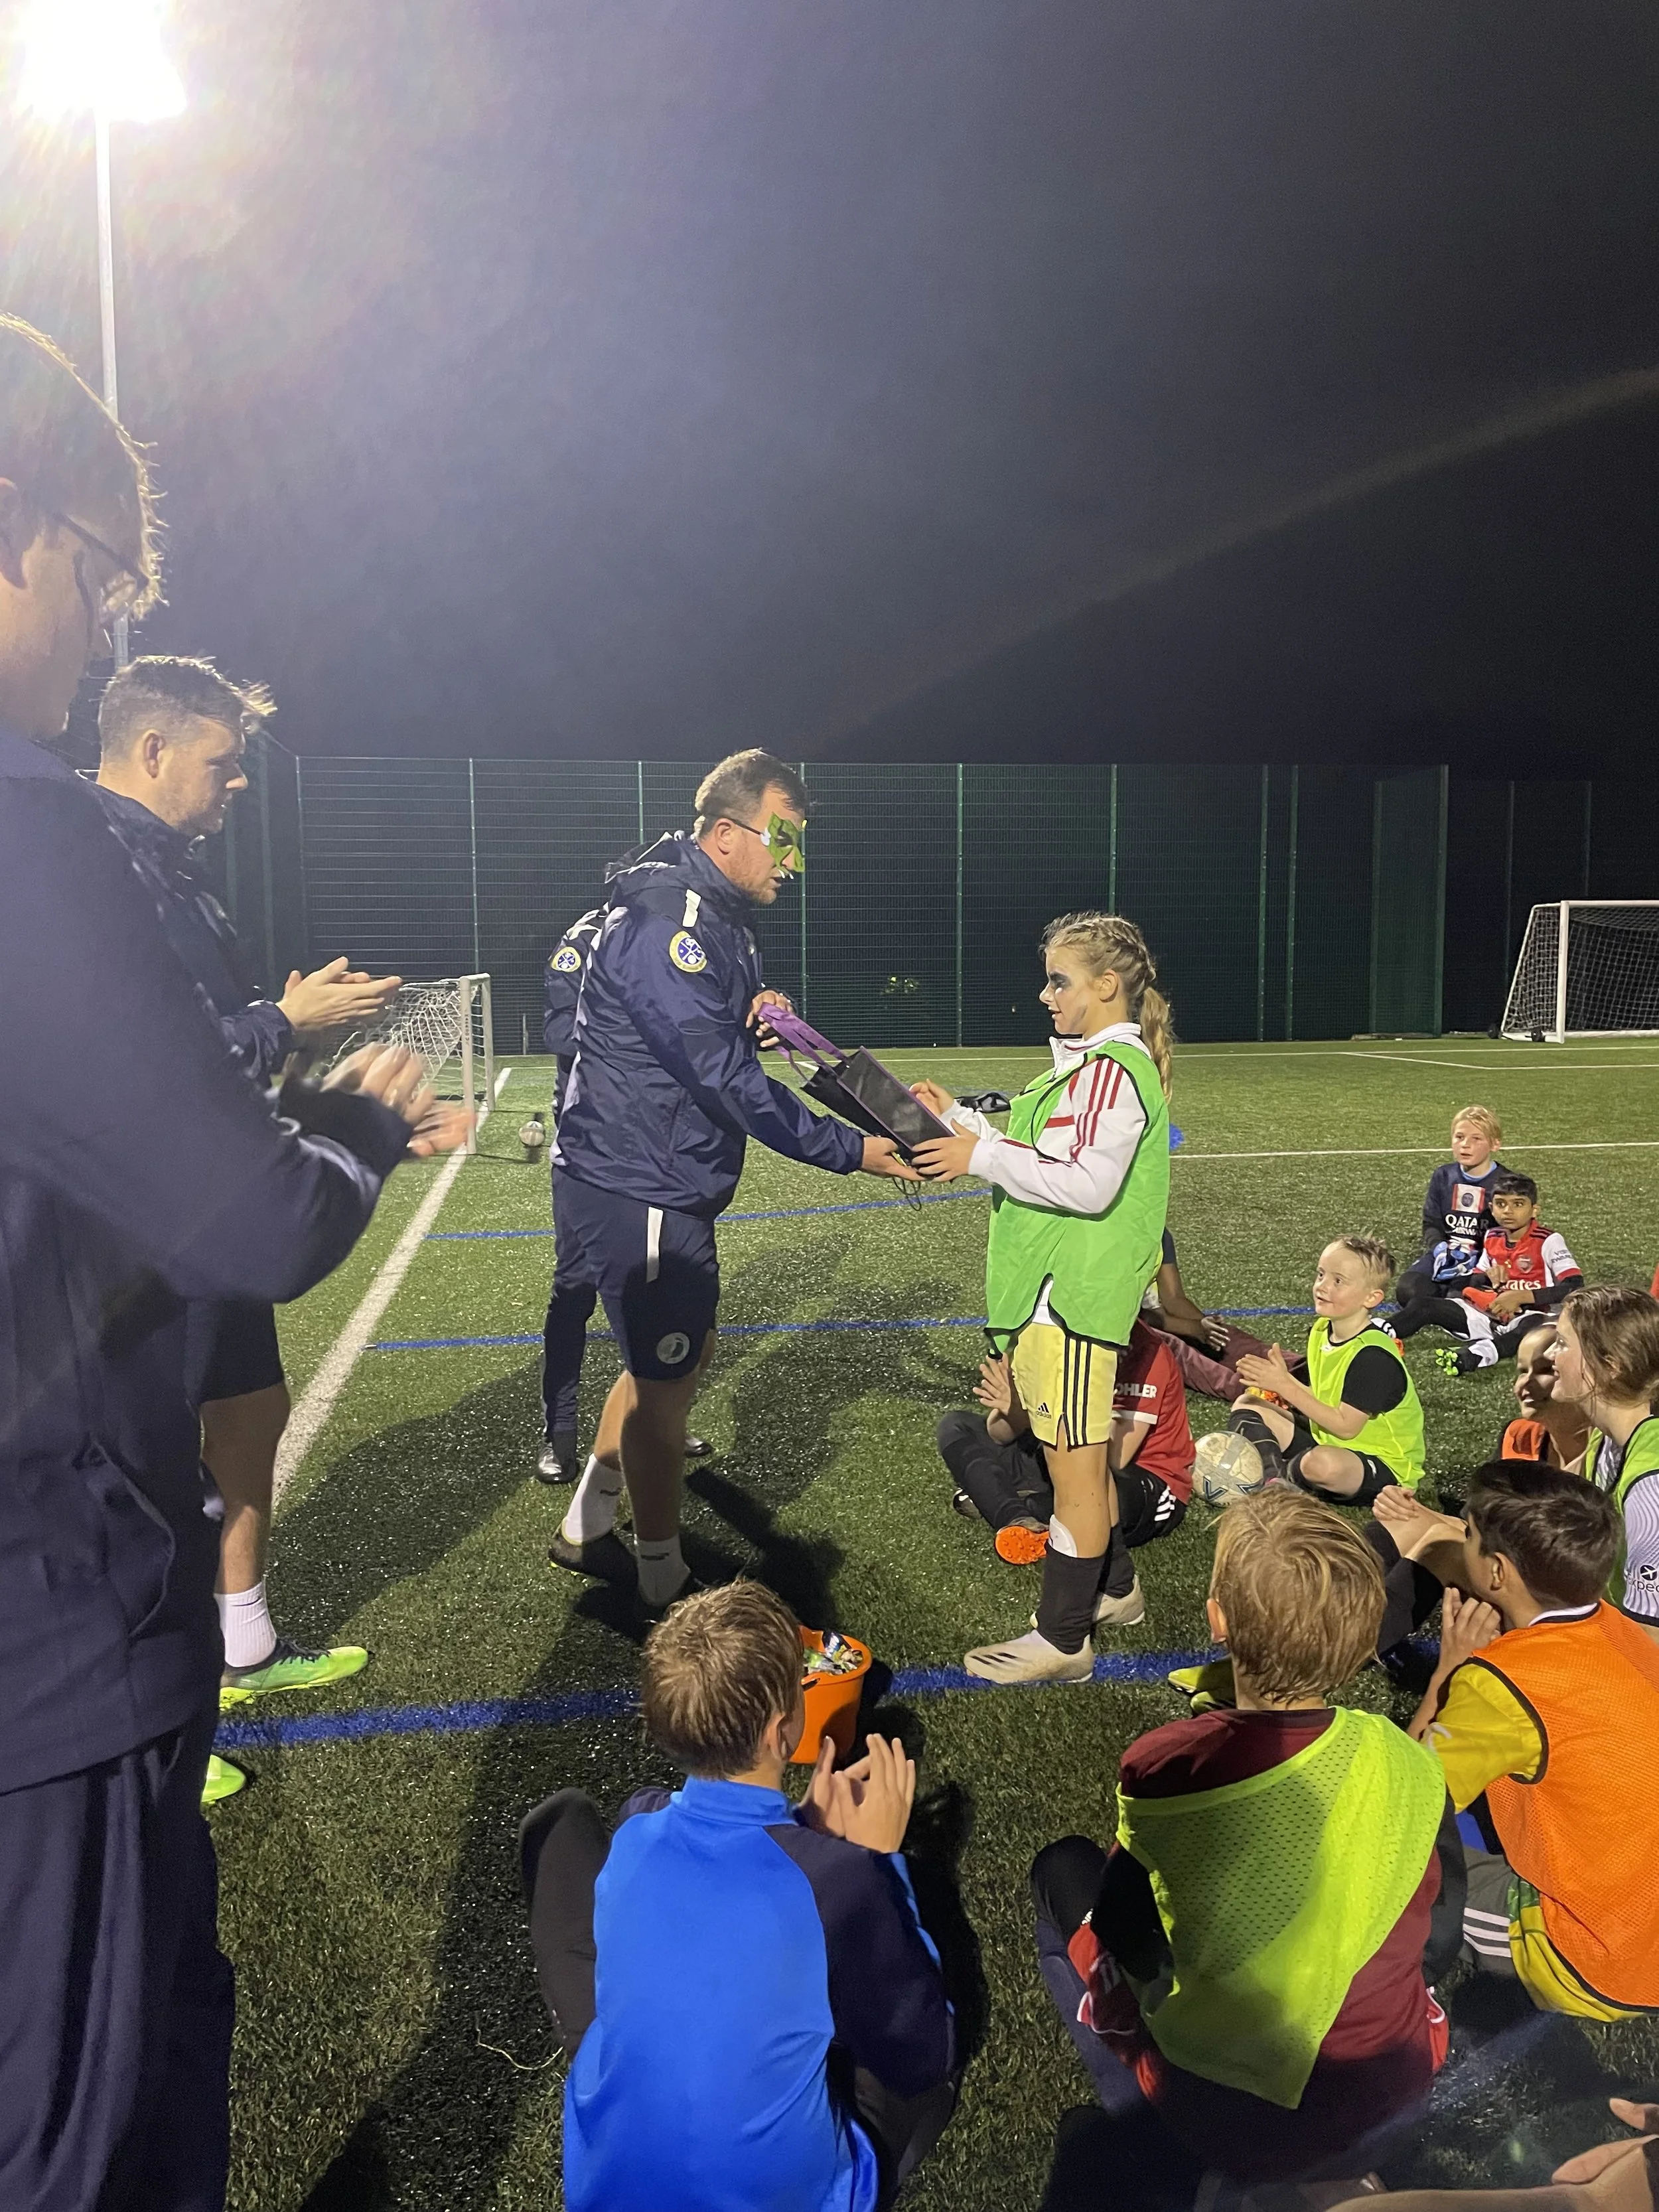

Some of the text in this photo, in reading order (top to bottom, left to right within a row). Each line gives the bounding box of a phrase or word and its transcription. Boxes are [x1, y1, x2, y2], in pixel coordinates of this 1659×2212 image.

[1445, 1214, 1489, 1230] QATAR
[1502, 1279, 1542, 1291] rates
[1114, 1383, 1157, 1398] OHLER
